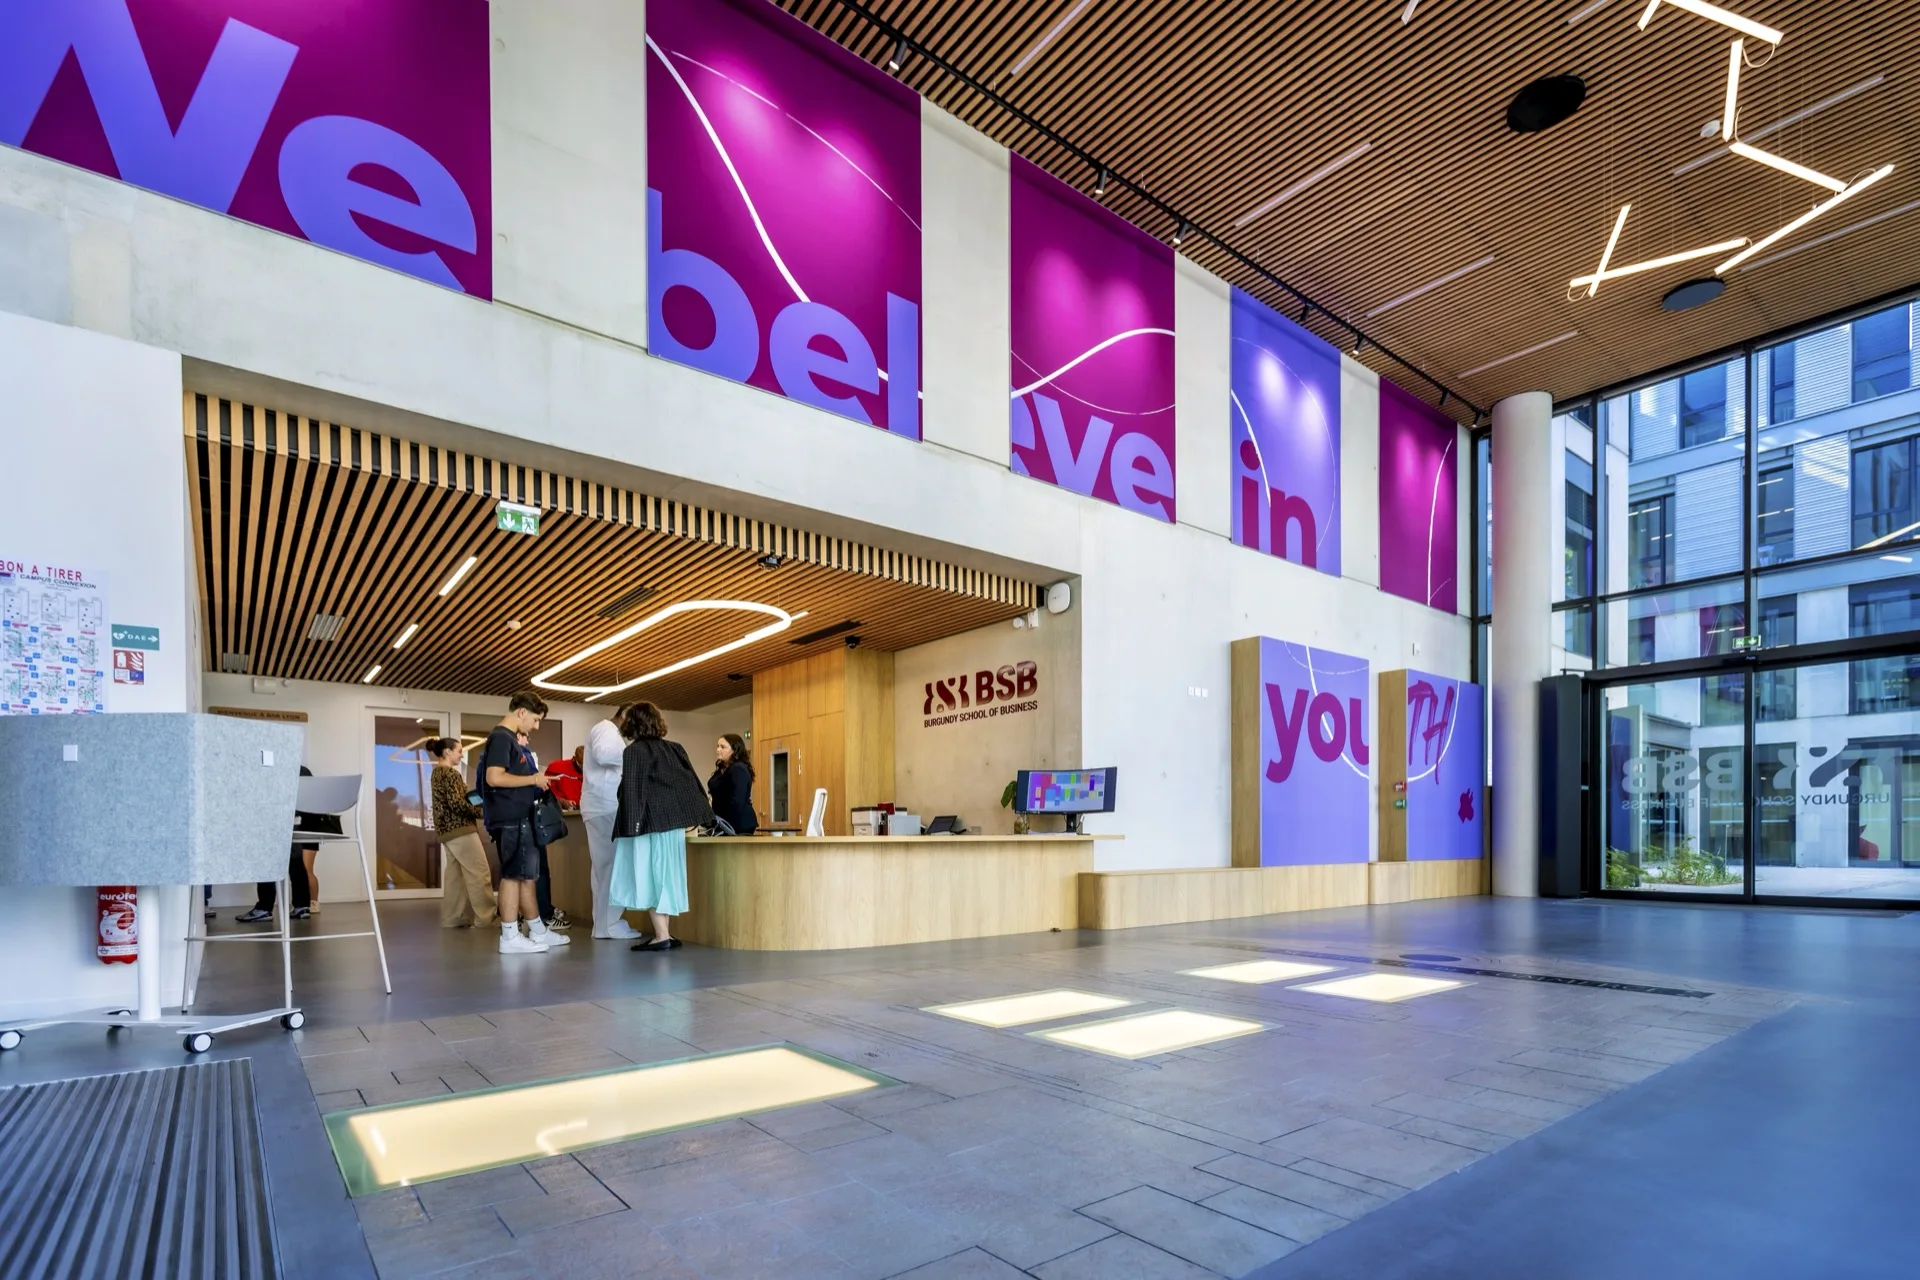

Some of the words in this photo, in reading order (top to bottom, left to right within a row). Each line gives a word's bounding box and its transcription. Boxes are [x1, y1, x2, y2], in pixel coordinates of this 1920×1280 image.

[1240, 439, 1317, 569] in
[0, 560, 23, 573] BON
[31, 565, 38, 576] A
[46, 566, 82, 581] TIRER
[20, 573, 52, 583] CAMPUS
[53, 578, 96, 589] CONNEXION
[975, 660, 1038, 706] BSB
[924, 713, 959, 728] BURGUNDY
[959, 709, 988, 723] SCHOOL
[988, 706, 999, 718] OF
[1000, 700, 1038, 716] BUSINESS
